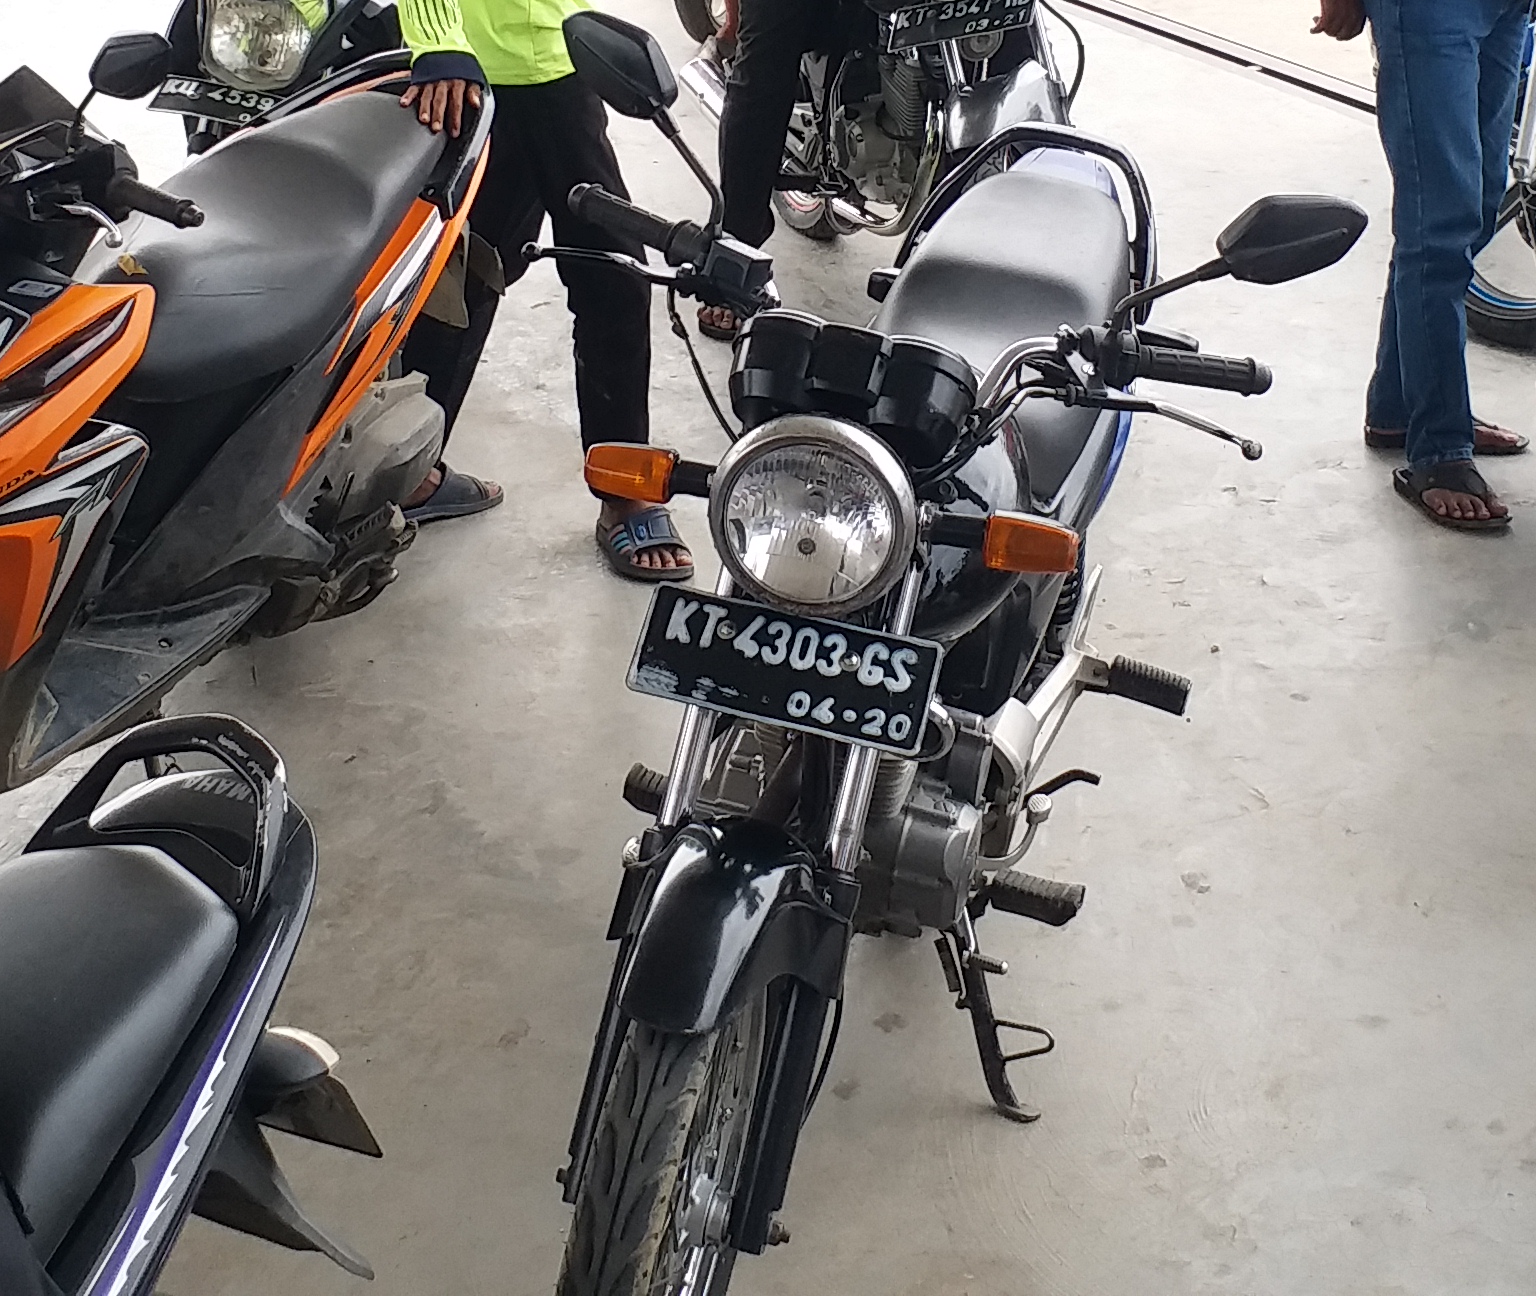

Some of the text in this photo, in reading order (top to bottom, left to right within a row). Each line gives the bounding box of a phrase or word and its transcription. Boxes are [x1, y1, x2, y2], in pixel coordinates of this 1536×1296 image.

[896, 6, 929, 31] KT
[665, 596, 920, 694] KT 4303 GS
